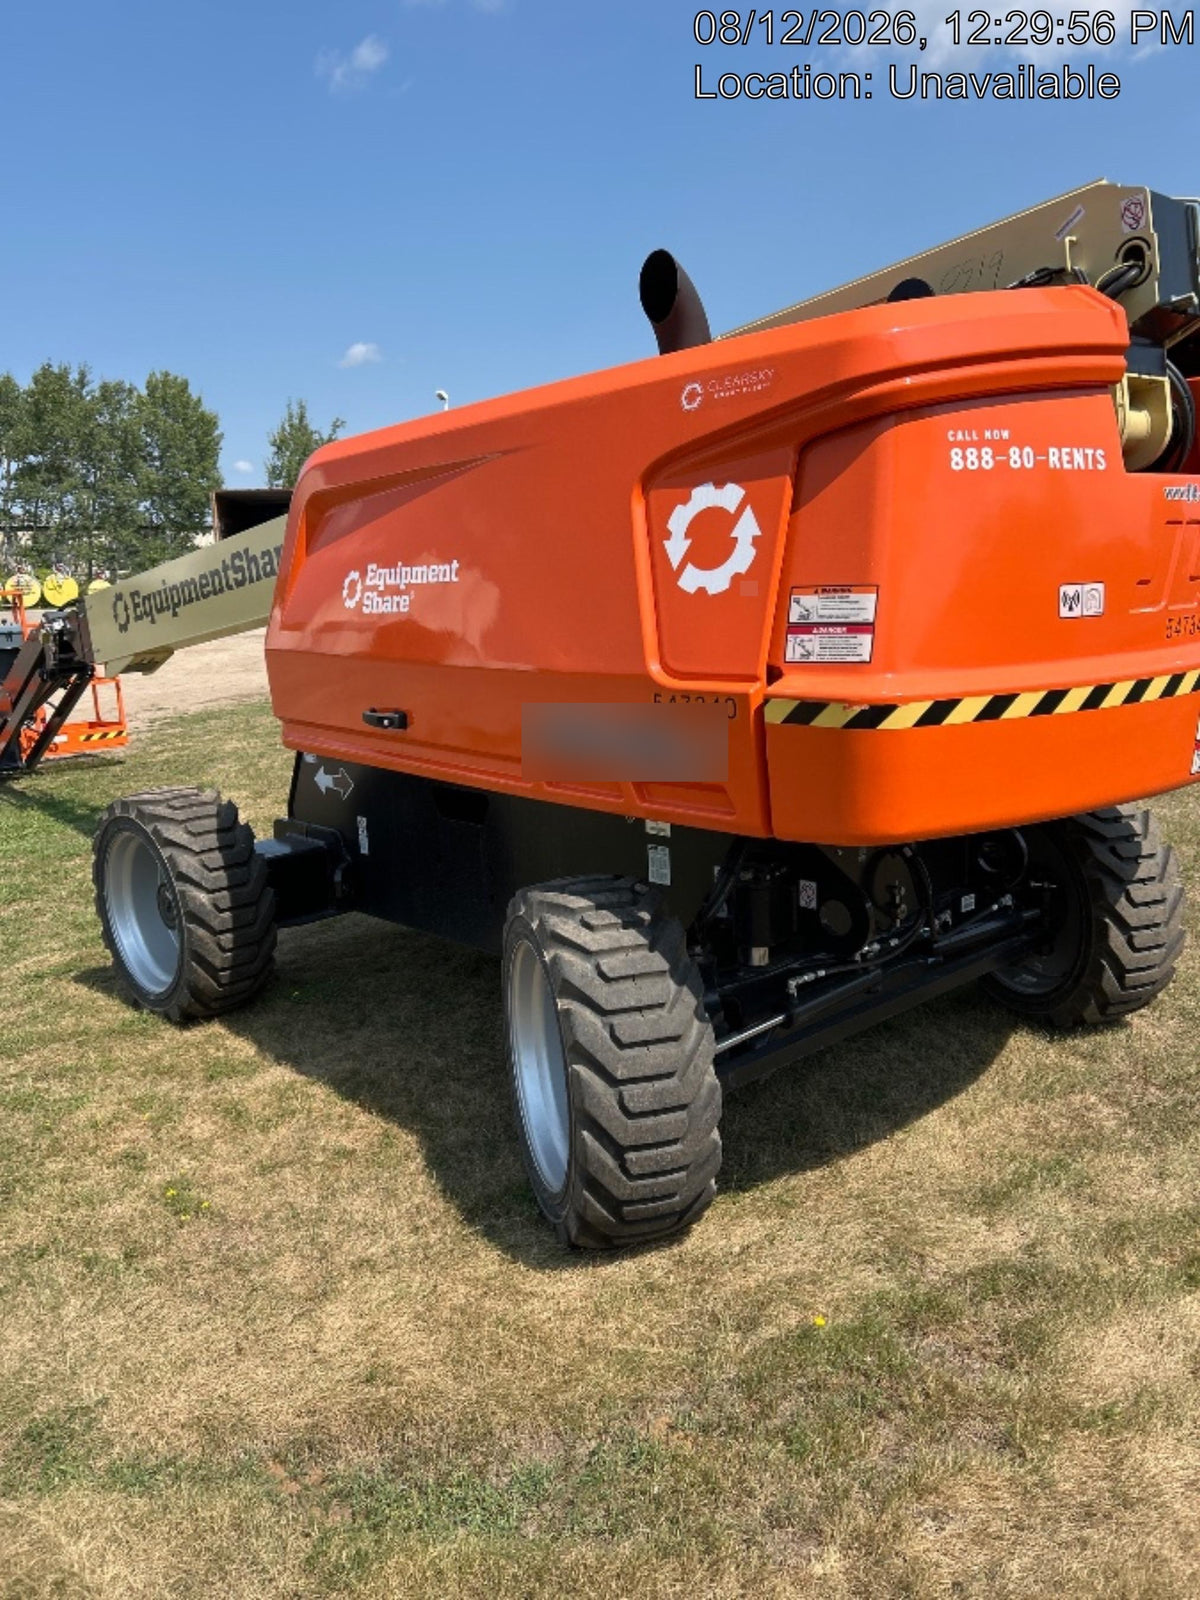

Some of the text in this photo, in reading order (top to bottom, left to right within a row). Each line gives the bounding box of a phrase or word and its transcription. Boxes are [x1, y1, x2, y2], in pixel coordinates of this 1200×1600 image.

[947, 429, 1010, 442] CALL NOW
[949, 446, 1107, 471] 888-80-RENTS
[365, 559, 459, 590] Equipment
